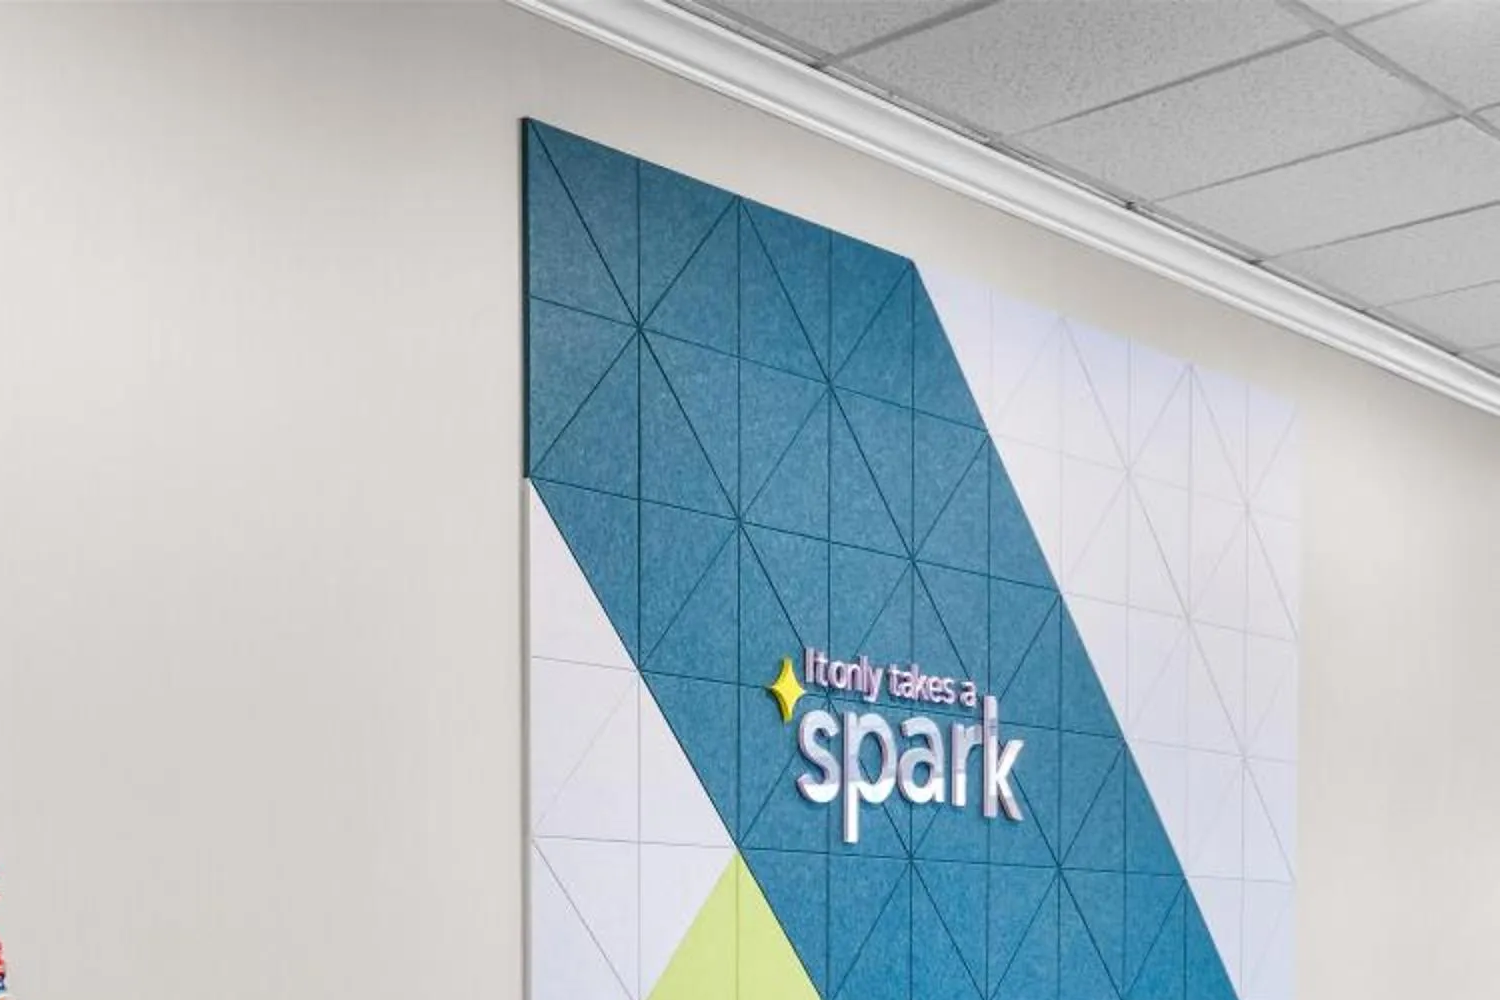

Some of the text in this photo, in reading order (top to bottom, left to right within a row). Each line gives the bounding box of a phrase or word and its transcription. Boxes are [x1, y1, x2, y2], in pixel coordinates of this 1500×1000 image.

[828, 655, 883, 702] only
[889, 663, 955, 704] takes
[960, 680, 977, 707] a
[797, 695, 1025, 843] spark
